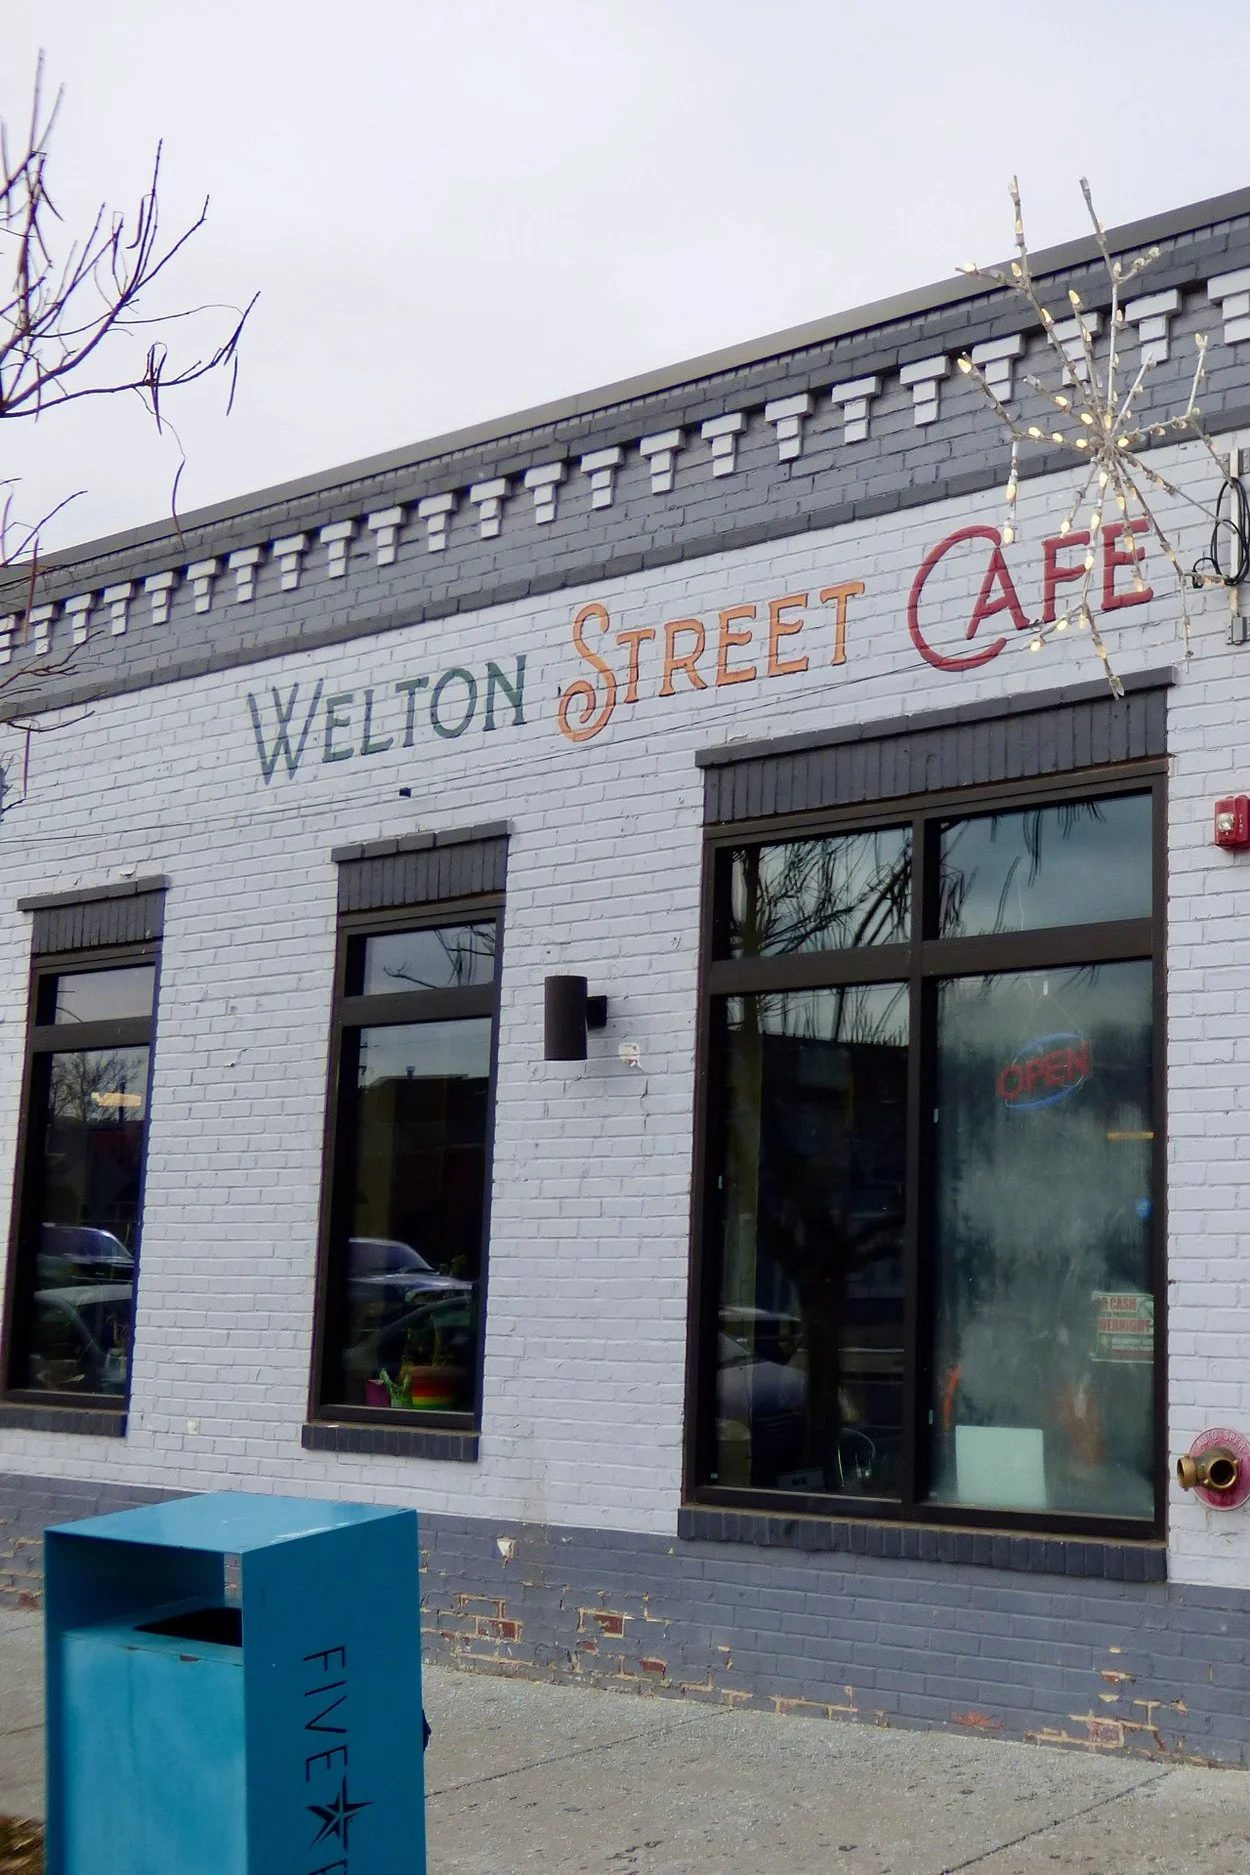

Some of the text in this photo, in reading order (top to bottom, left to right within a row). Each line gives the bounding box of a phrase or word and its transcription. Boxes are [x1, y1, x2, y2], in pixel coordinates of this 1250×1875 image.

[248, 517, 1155, 786] WELTON STREET CAFE
[998, 1041, 1090, 1101] OPEN
[1196, 1430, 1218, 1449] AUTO
[303, 1645, 348, 1783] FIVE
